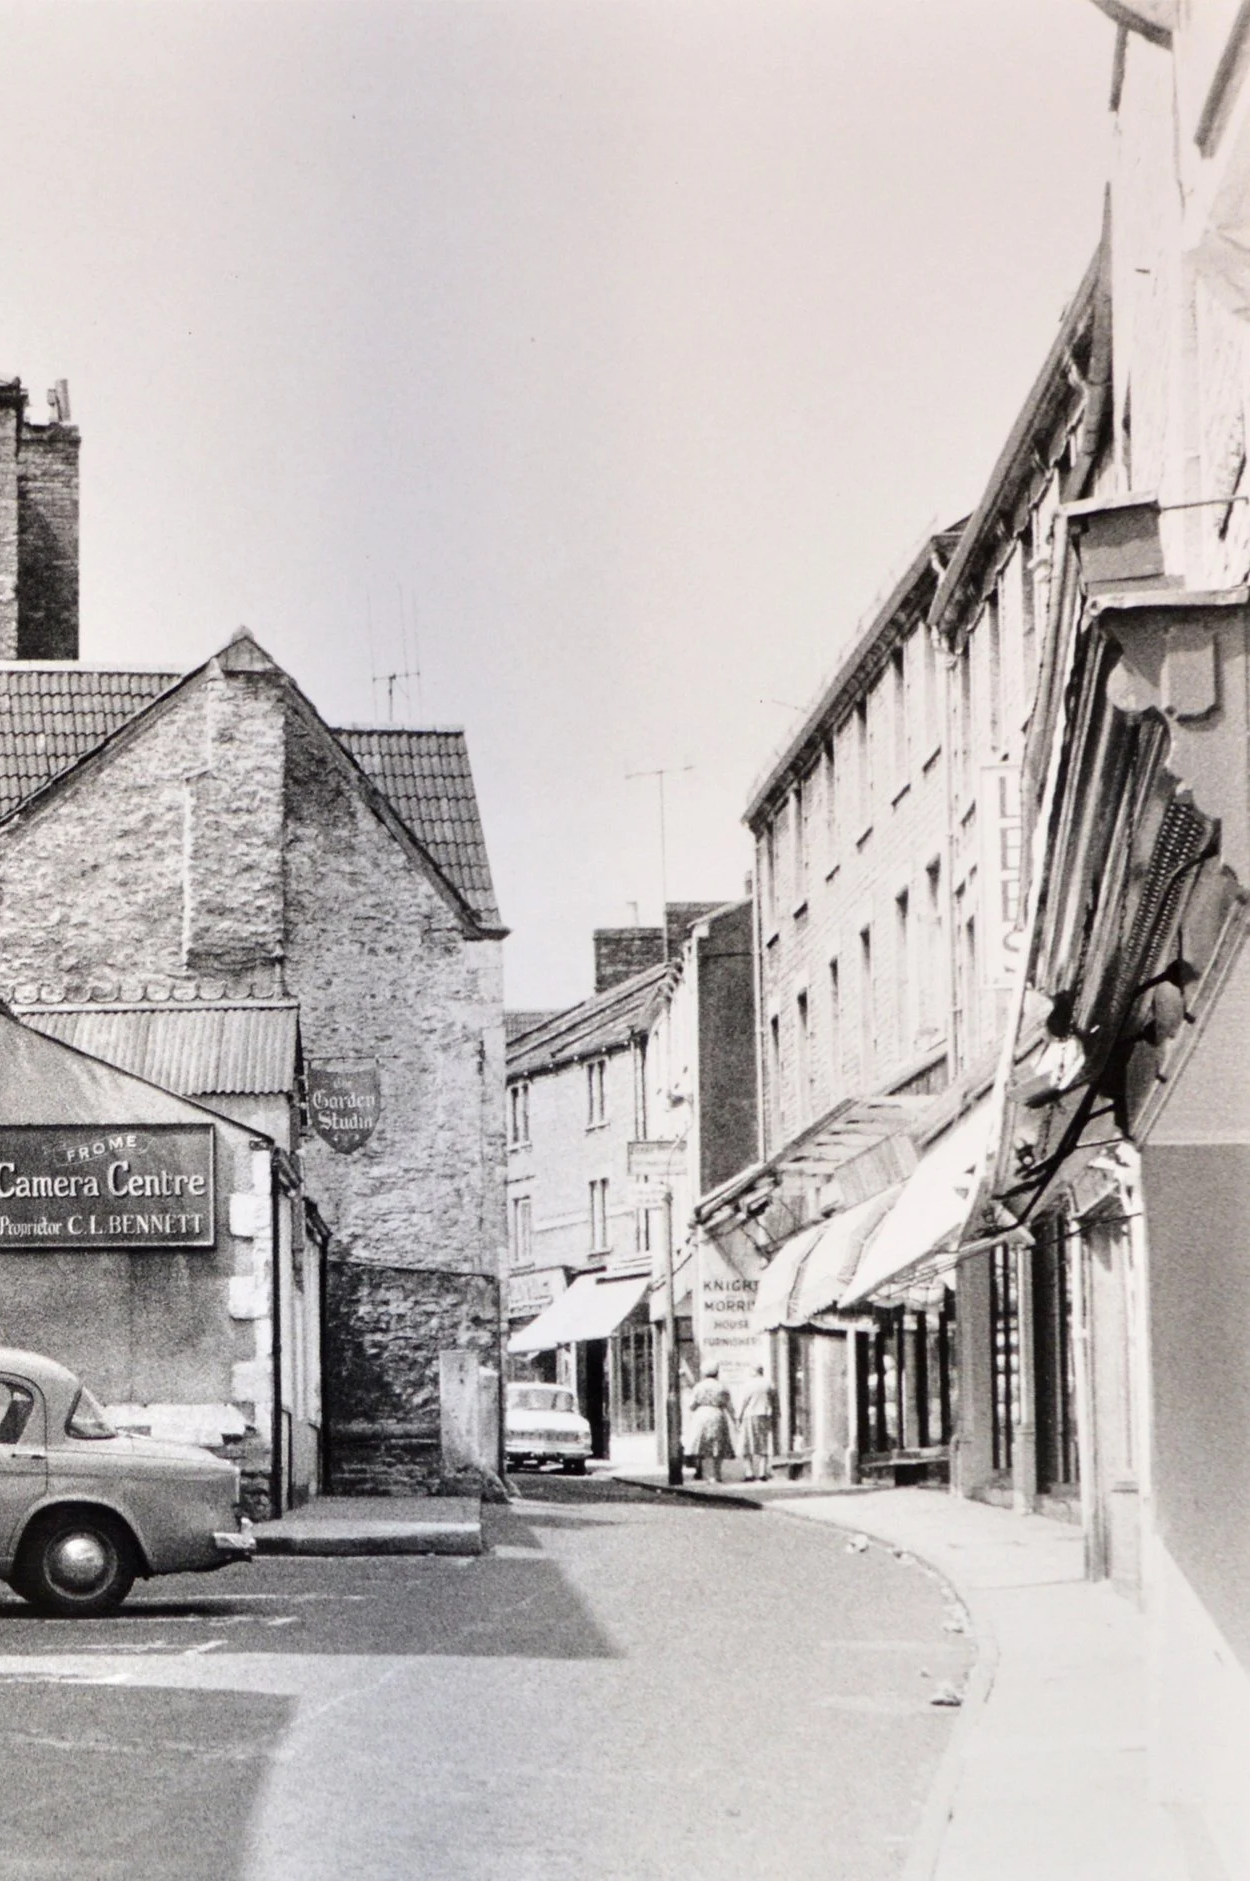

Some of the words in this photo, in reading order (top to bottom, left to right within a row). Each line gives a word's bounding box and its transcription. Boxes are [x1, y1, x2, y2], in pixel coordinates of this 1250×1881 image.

[312, 1088, 375, 1110] Garden
[66, 1134, 138, 1162] FROME
[108, 1160, 206, 1198] Centre
[0, 1216, 62, 1238] Proprietor
